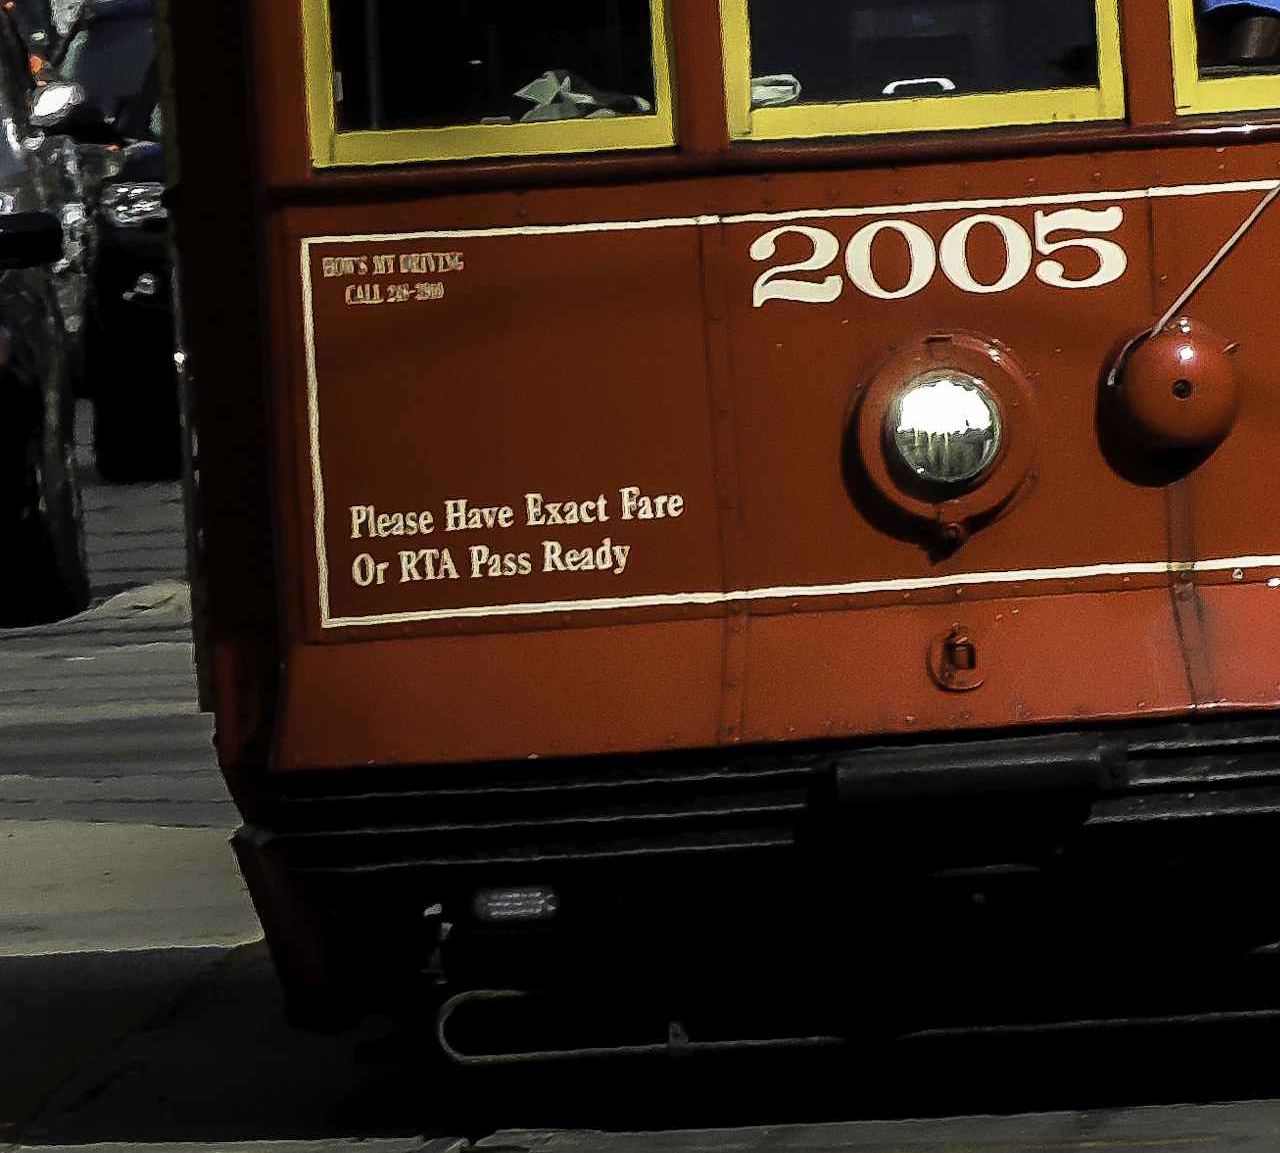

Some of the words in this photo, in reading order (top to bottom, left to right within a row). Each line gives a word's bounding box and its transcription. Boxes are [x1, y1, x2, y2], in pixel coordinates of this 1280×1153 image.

[749, 205, 1128, 307] 2005
[345, 284, 384, 305] CALL
[350, 505, 435, 539] Please
[444, 498, 515, 532] Have
[524, 492, 611, 526] Exact
[619, 485, 685, 521] Fare
[351, 552, 390, 586] Or
[398, 547, 460, 583] RTA
[468, 544, 533, 578] Pass
[541, 536, 631, 575] Ready
